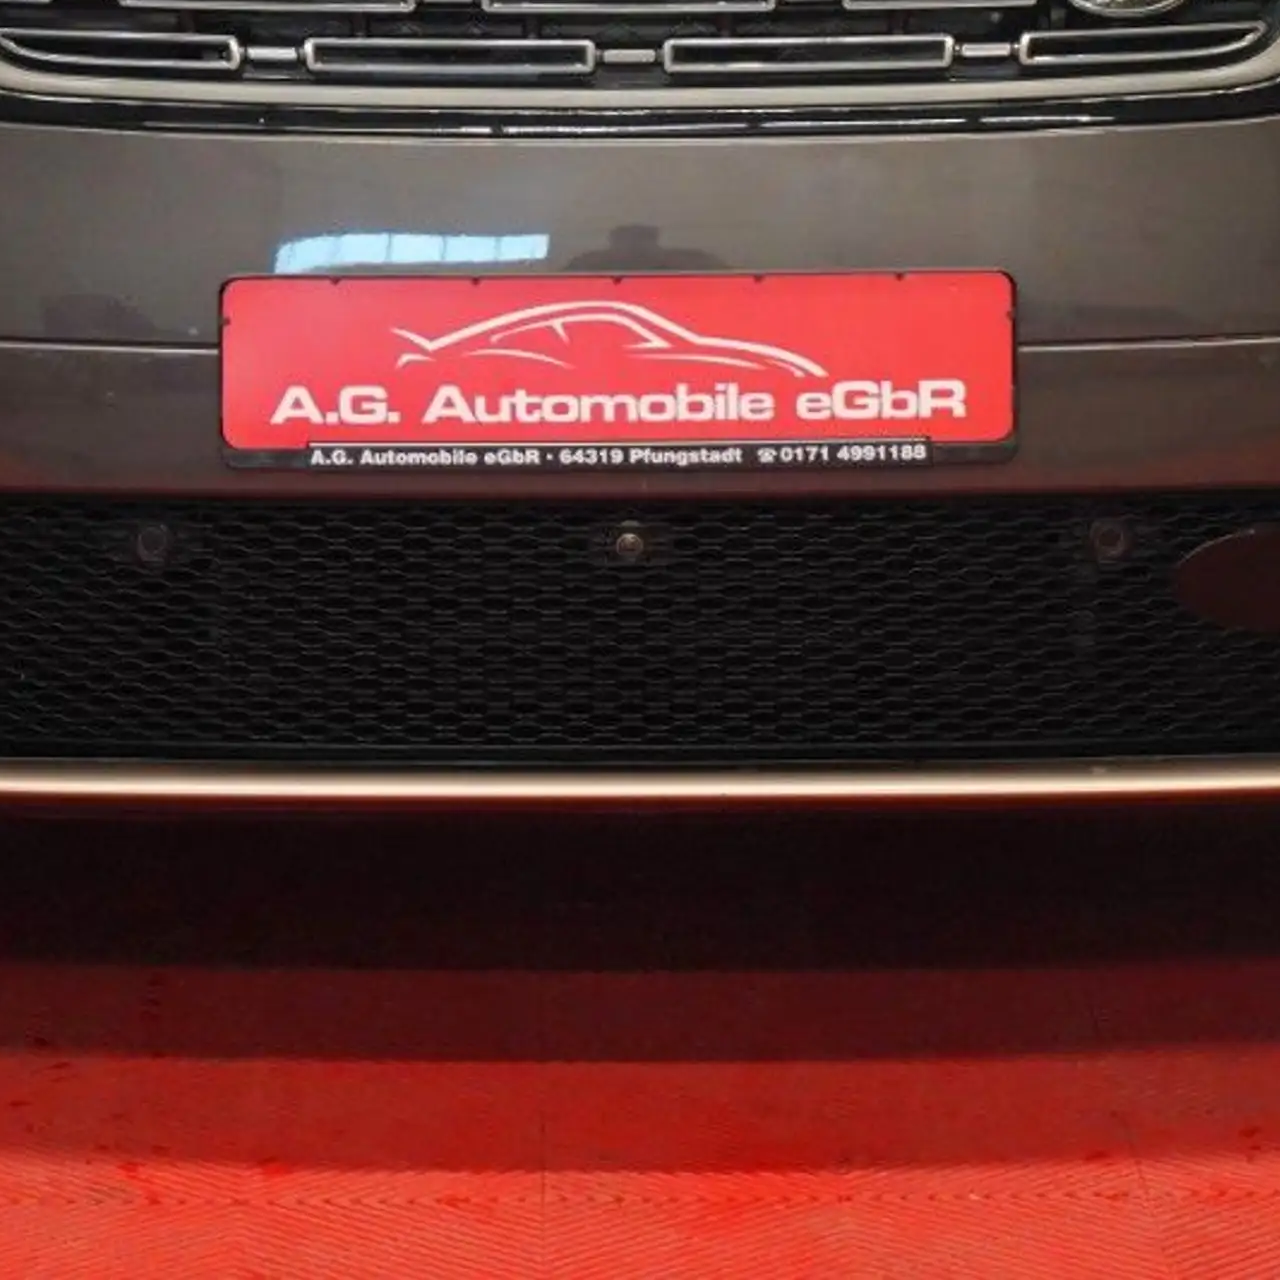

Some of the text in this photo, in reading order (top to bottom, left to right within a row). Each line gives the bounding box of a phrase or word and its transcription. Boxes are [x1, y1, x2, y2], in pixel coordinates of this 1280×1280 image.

[270, 379, 968, 426] A.G. Automobile eGbR
[310, 442, 927, 467] A.G. Automobile eGbR 64319 Pfungstadt 0171 4991188
